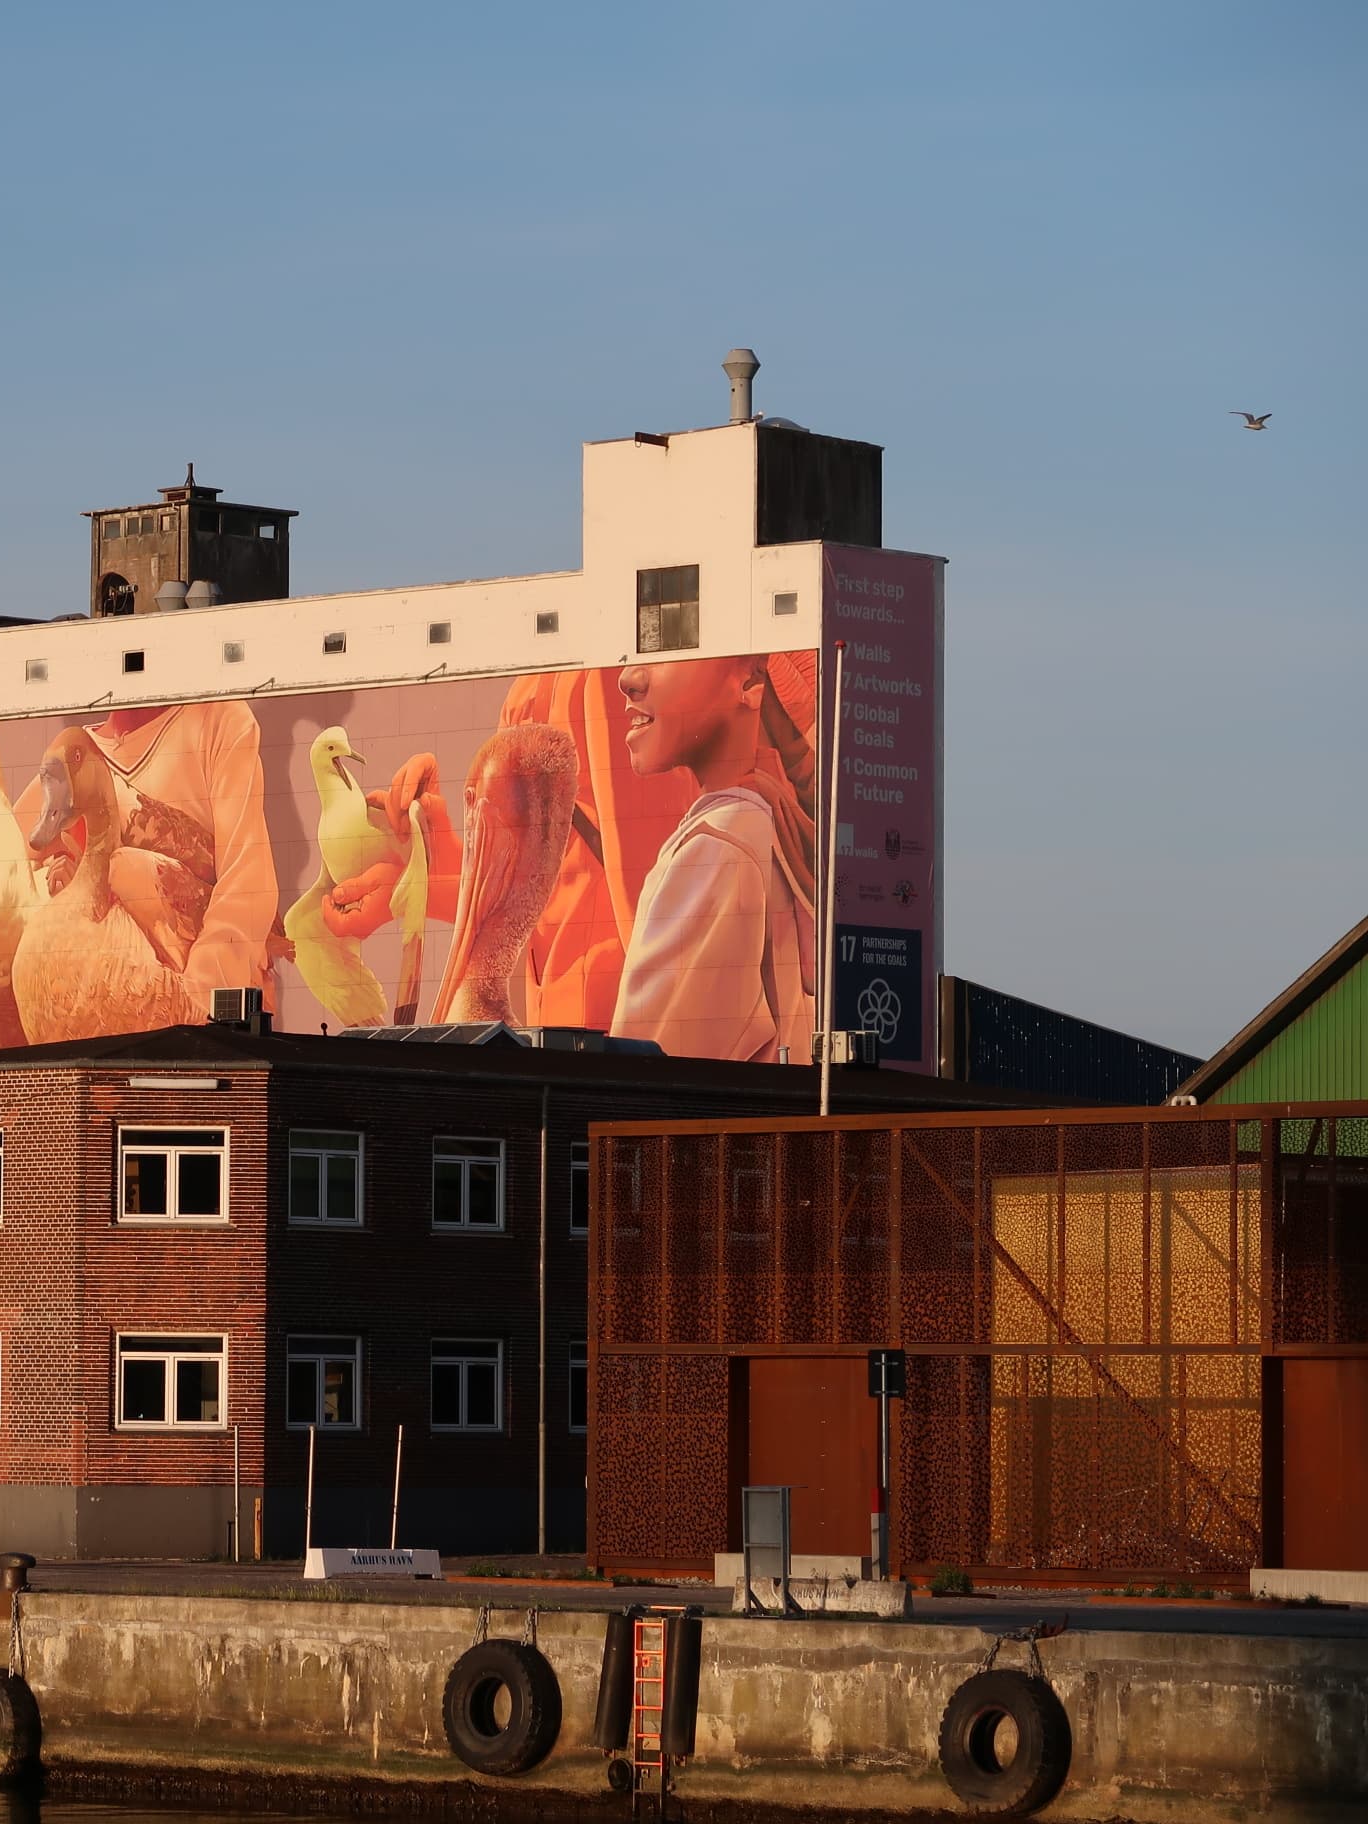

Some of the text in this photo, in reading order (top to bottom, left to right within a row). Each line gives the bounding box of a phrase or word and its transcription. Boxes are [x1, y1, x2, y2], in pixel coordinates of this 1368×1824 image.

[836, 574, 904, 602] First step
[835, 600, 905, 624] towards...
[854, 642, 891, 663] Walls
[843, 671, 922, 697] 7 Artworks
[842, 701, 900, 724] 7 Global
[854, 728, 895, 749] Goals
[843, 757, 918, 780] 1 Common
[854, 783, 904, 804] Future
[840, 935, 856, 962] 17
[862, 936, 907, 951] PARTNERSHIPS
[862, 952, 907, 967] FOR THE GOALS
[351, 1555, 413, 1566] AARHUS HAVN
